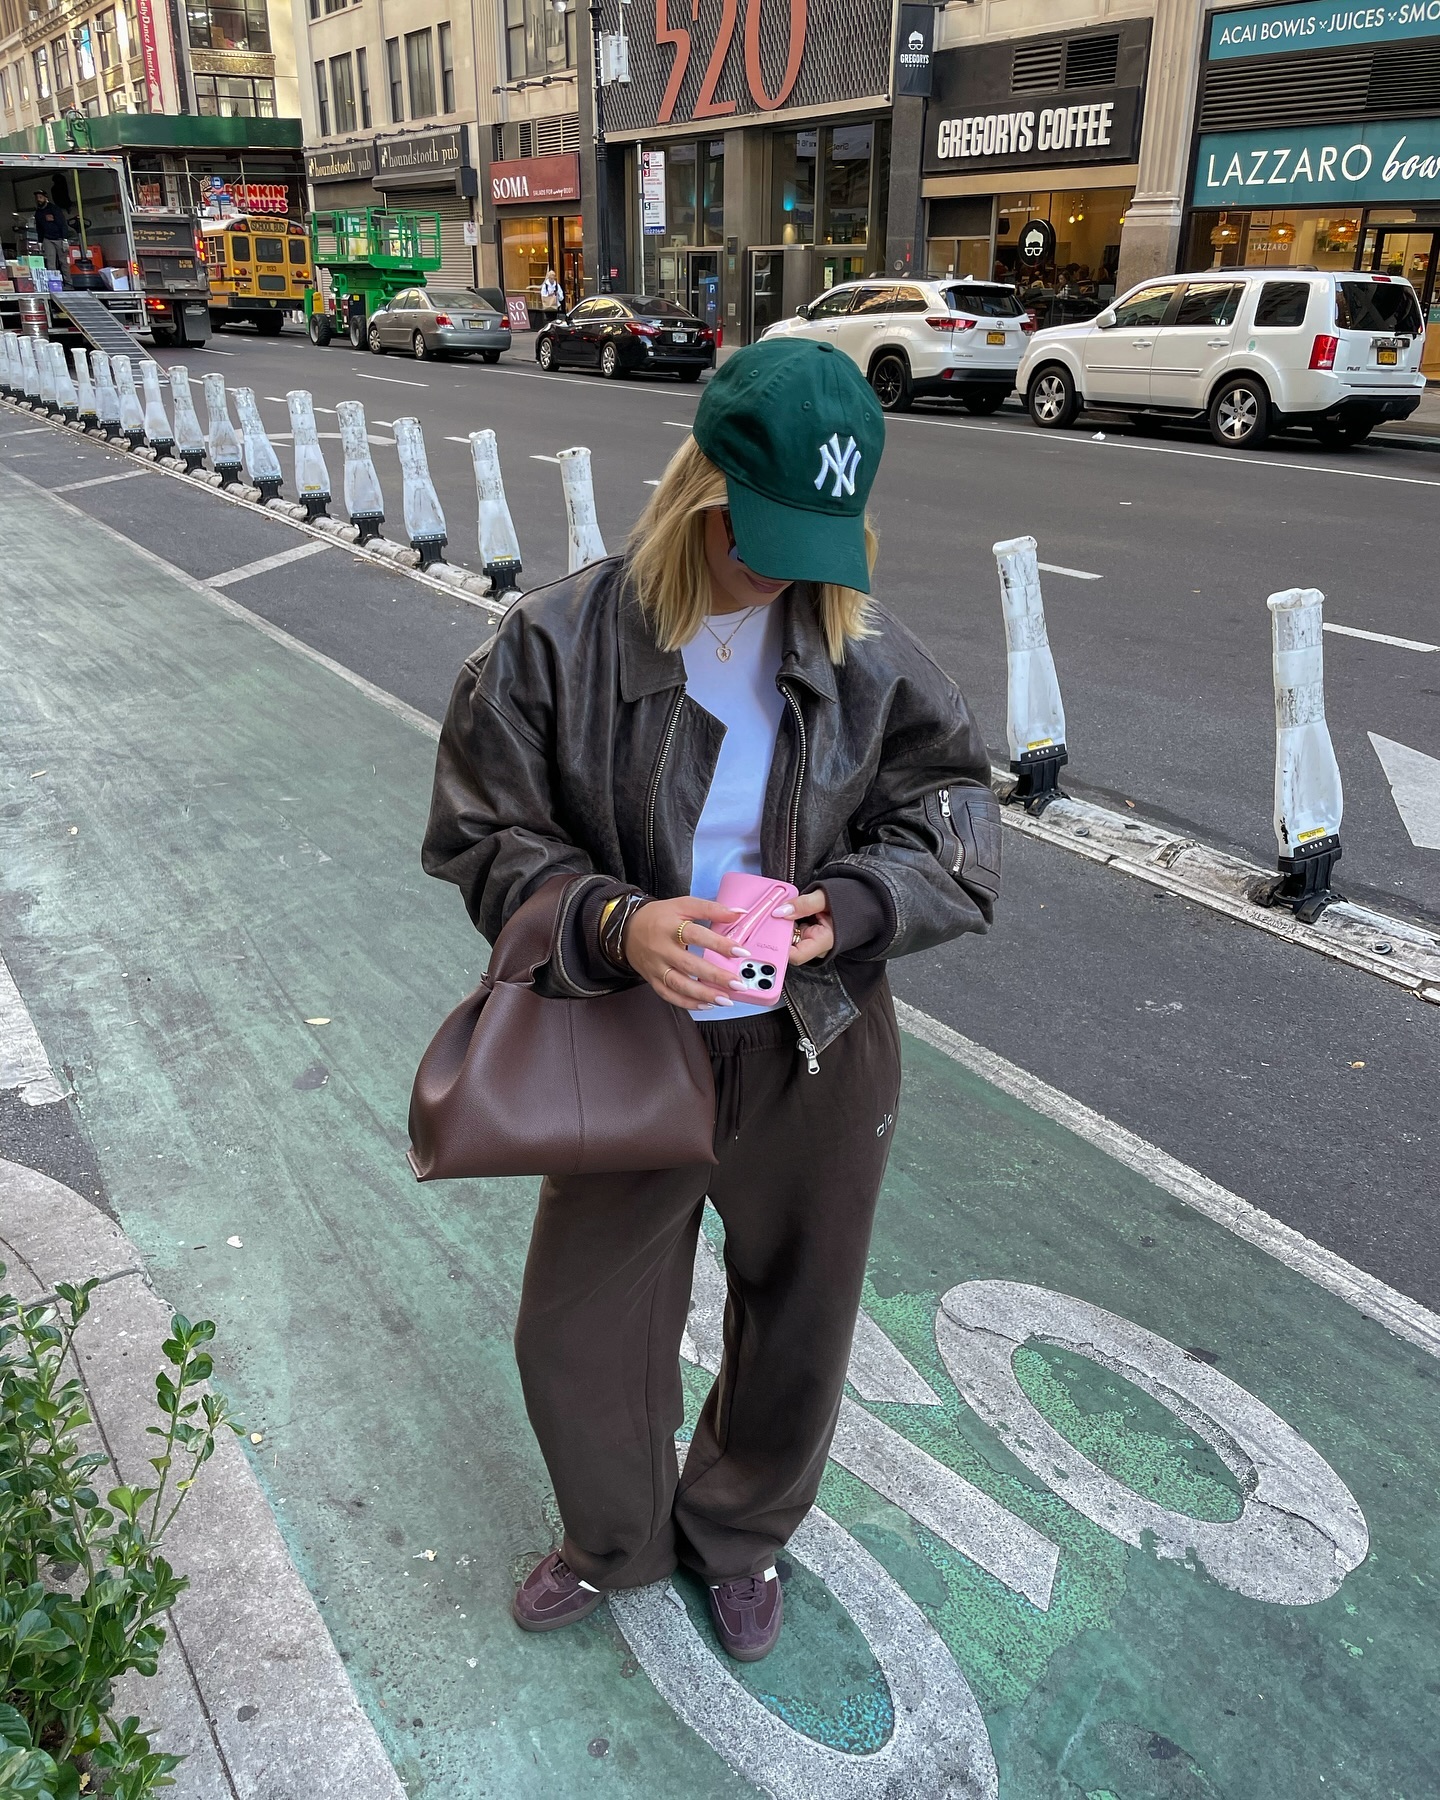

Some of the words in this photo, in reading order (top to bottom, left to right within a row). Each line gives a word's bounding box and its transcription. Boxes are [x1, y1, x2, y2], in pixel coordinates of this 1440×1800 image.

[1219, 24, 1257, 45] ACAI
[1261, 16, 1316, 40] BOWLS
[1327, 7, 1385, 32] JUICES
[1398, 0, 1440, 24] SMO
[145, 44, 155, 81] America
[656, 0, 807, 124] 520
[900, 53, 930, 64] GREGORYS
[937, 111, 1035, 159] GREGORYS
[1037, 102, 1114, 151] COFFEE
[313, 151, 355, 177] houndstooth
[357, 149, 371, 175] pub
[388, 139, 440, 168] houndstooth
[441, 135, 459, 165] pub
[1206, 144, 1373, 187] LAZZARO
[492, 175, 530, 200] SOMA
[1253, 243, 1288, 251] LAZZARO
[508, 301, 525, 311] SO
[510, 311, 527, 321] MA
[814, 432, 862, 498] NY
